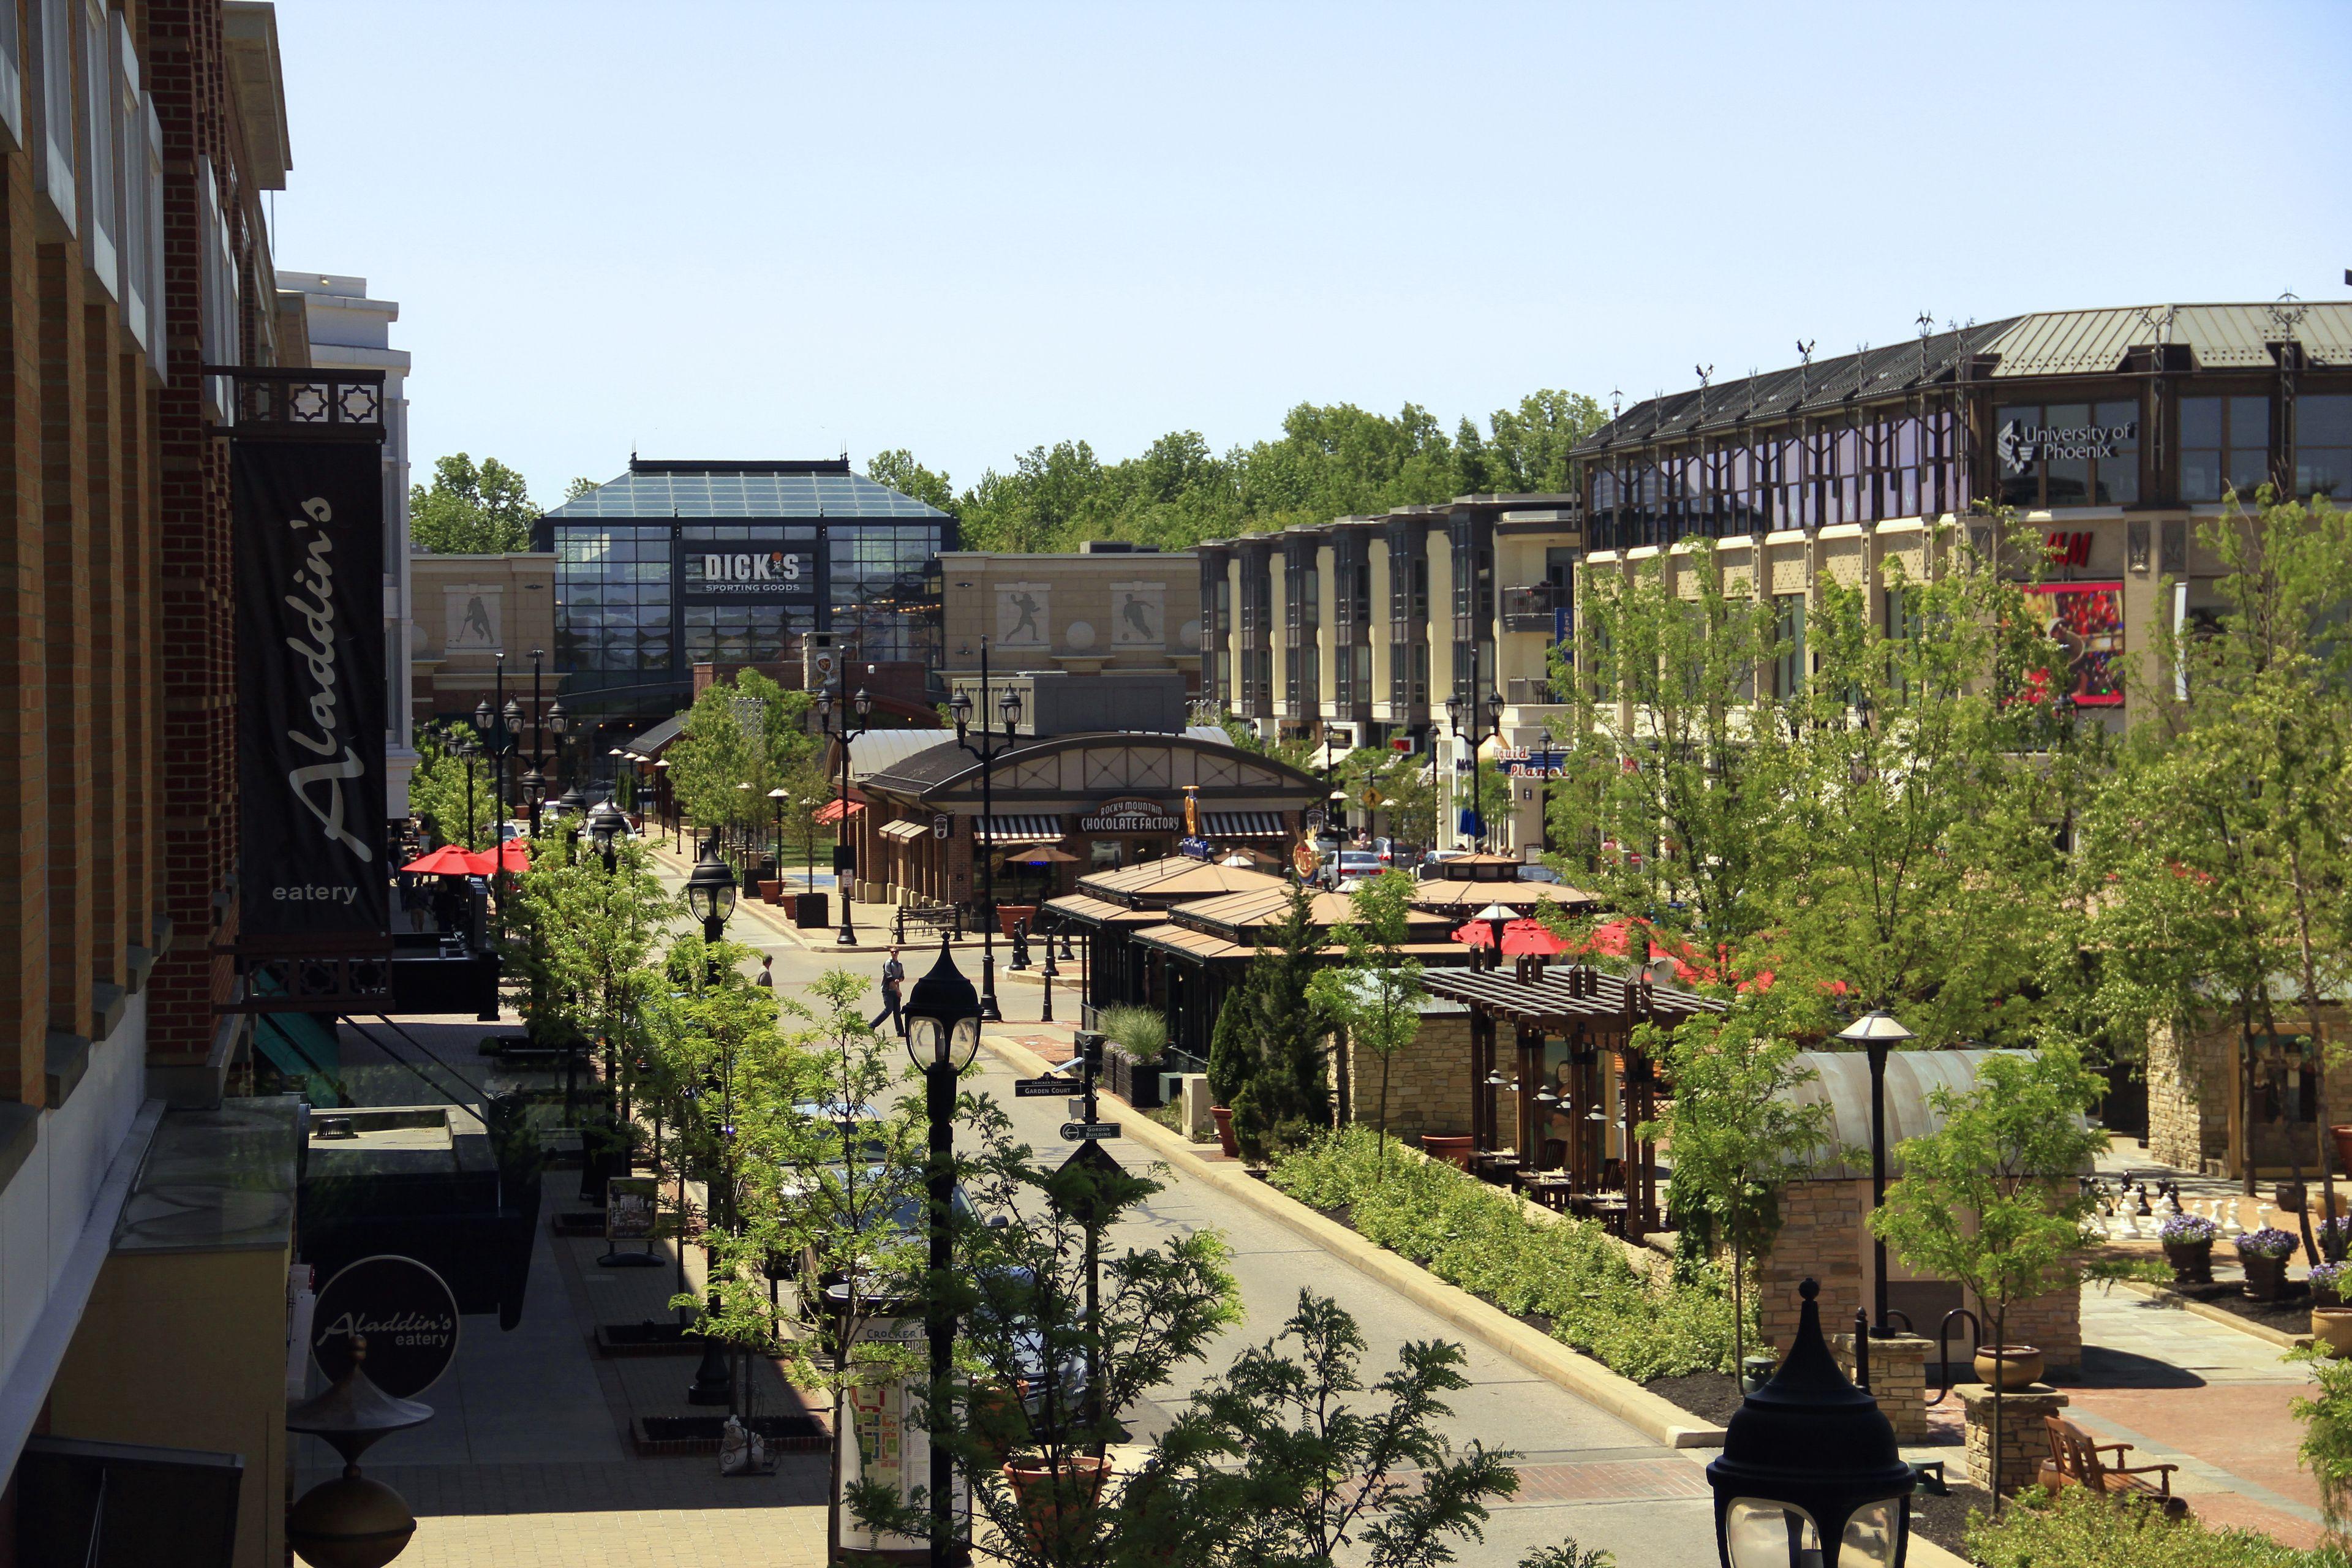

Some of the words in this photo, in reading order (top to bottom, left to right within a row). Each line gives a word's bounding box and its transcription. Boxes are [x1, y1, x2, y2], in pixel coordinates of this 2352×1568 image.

[2024, 424, 2108, 444] University
[2112, 421, 2132, 440] of
[2043, 443, 2113, 460] Phoenix
[285, 496, 372, 862] Aladdin's
[1100, 802, 1123, 816] ROCKY
[1125, 801, 1163, 816] MOUNTAIN
[1081, 817, 1138, 832] CHOCOLATE
[1139, 816, 1179, 831] FACTORY
[272, 882, 358, 905] eatery
[316, 1311, 452, 1346] Aladdin's
[867, 1329, 917, 1339] CROCKER
[395, 1332, 449, 1348] eatery
